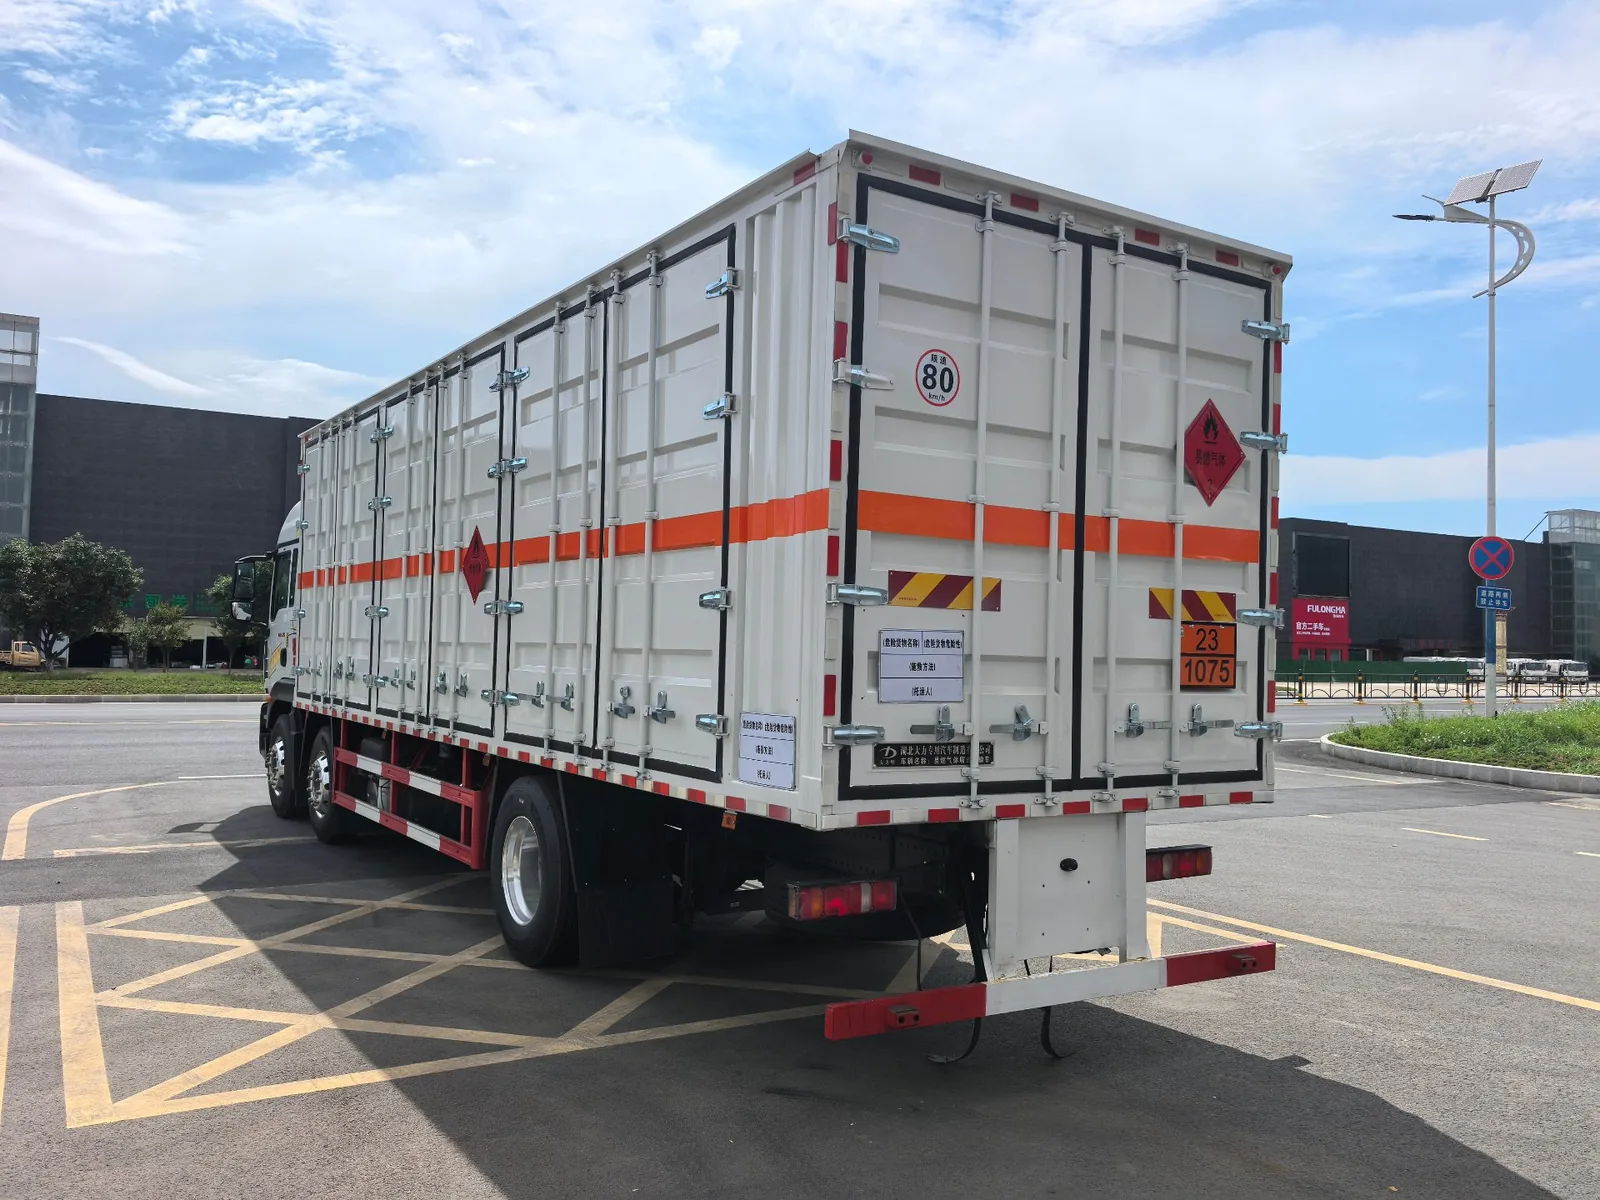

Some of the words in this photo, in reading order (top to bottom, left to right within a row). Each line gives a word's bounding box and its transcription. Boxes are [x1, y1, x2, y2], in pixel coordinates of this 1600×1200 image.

[922, 363, 954, 393] 80
[929, 392, 945, 401] km/h
[1196, 447, 1227, 468] 易燃气体
[1207, 478, 1214, 490] 2
[1480, 597, 1508, 607] 禁止停车
[1307, 604, 1346, 615] FULONGMA
[1296, 621, 1324, 631] 官方二手车
[1195, 628, 1219, 652] 23
[1184, 658, 1230, 683] 1075
